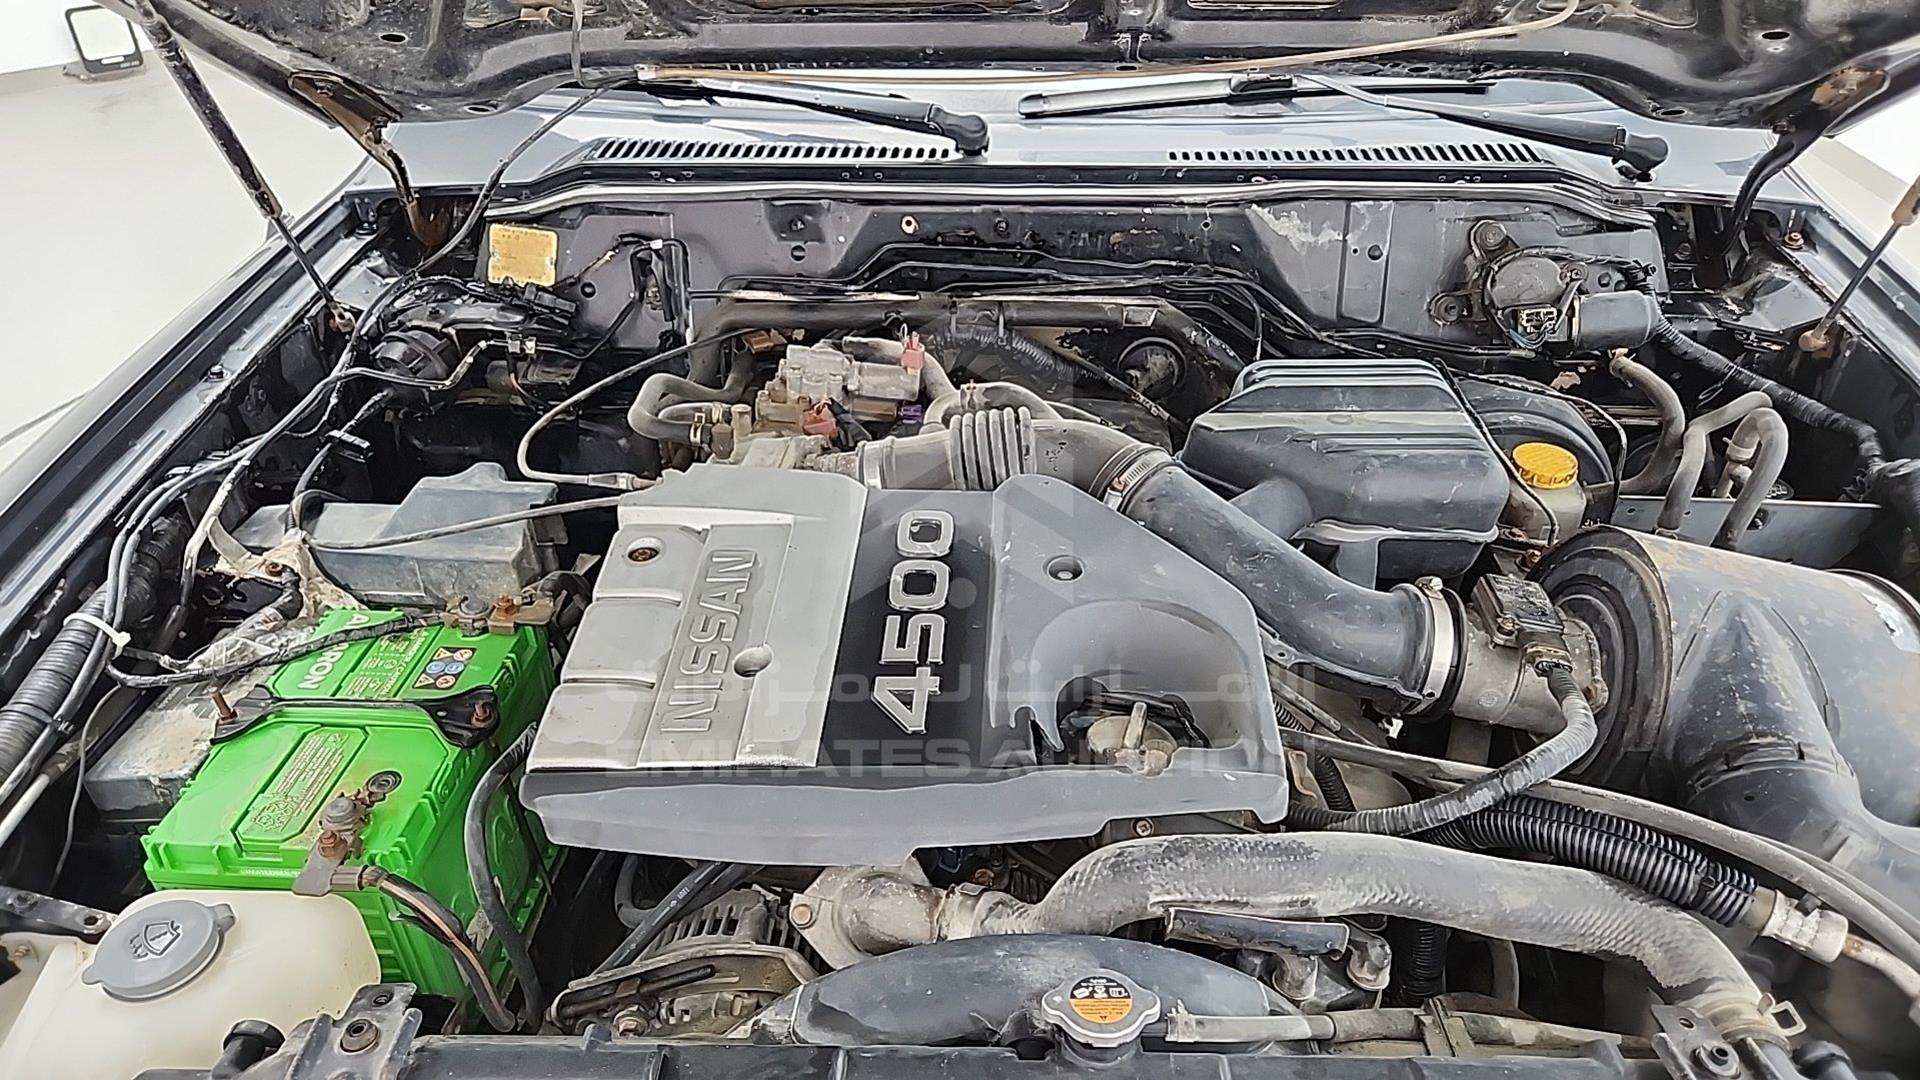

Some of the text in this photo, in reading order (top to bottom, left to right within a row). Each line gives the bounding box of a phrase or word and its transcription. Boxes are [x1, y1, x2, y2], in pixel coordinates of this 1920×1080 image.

[297, 613, 370, 689] ARON
[660, 550, 758, 732] NISSAN
[870, 509, 954, 734] 4500
